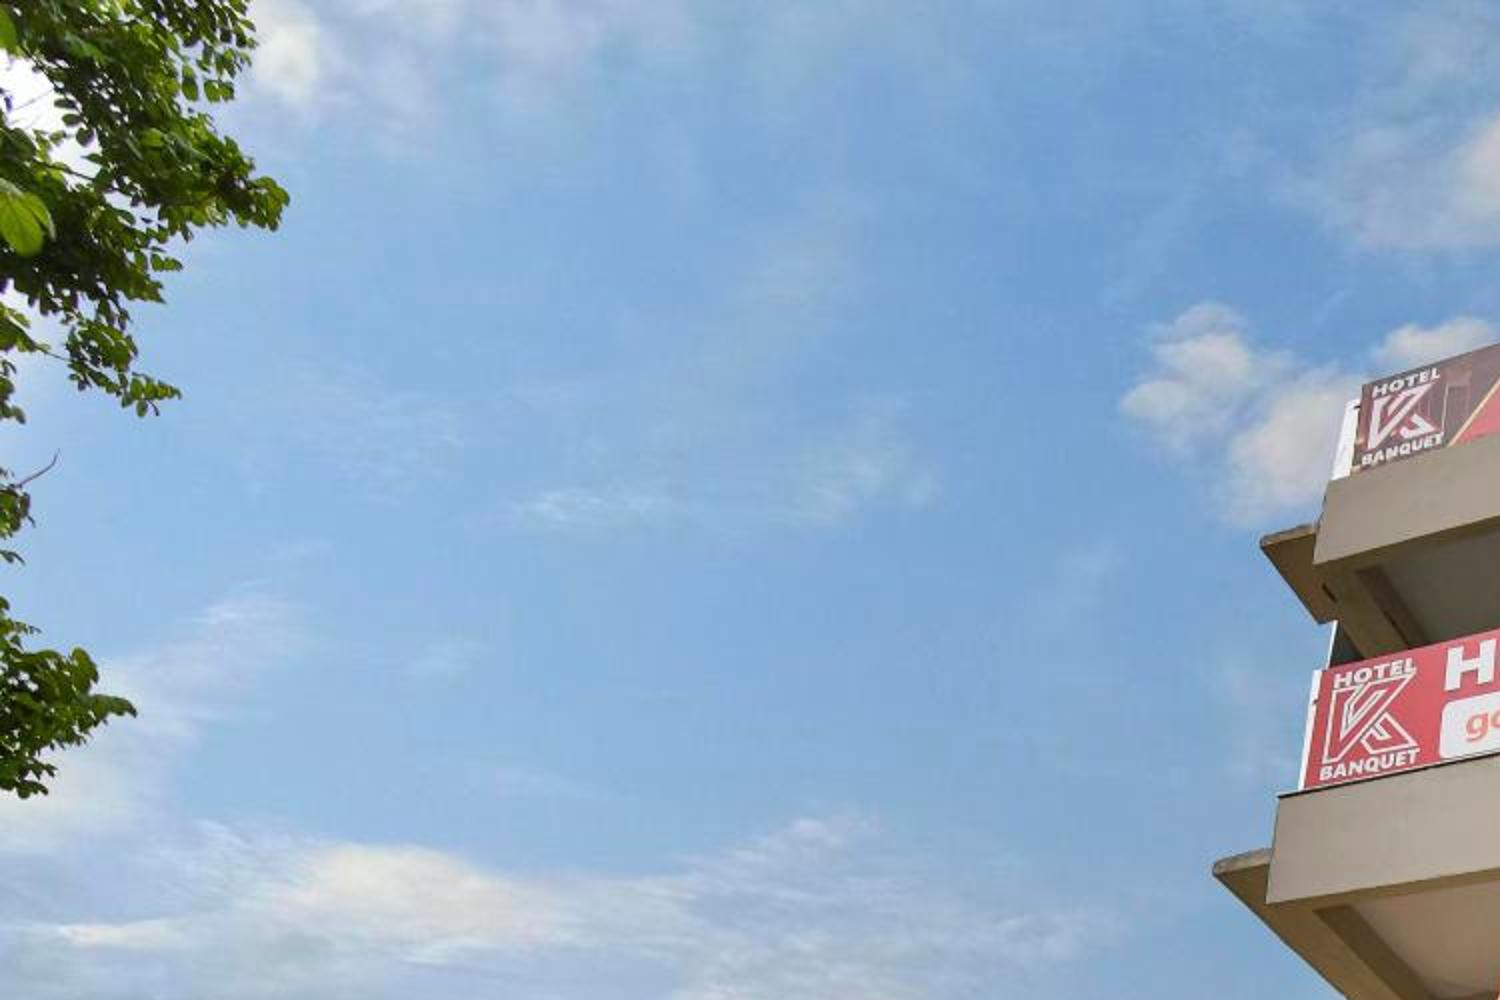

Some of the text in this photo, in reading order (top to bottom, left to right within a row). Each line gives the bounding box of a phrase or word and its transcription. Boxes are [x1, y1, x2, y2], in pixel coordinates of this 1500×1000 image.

[1372, 368, 1440, 397] HOTEL
[1361, 432, 1444, 465] BANQUET
[1334, 658, 1416, 689] HOTEL
[1320, 748, 1420, 780] BANQUET
